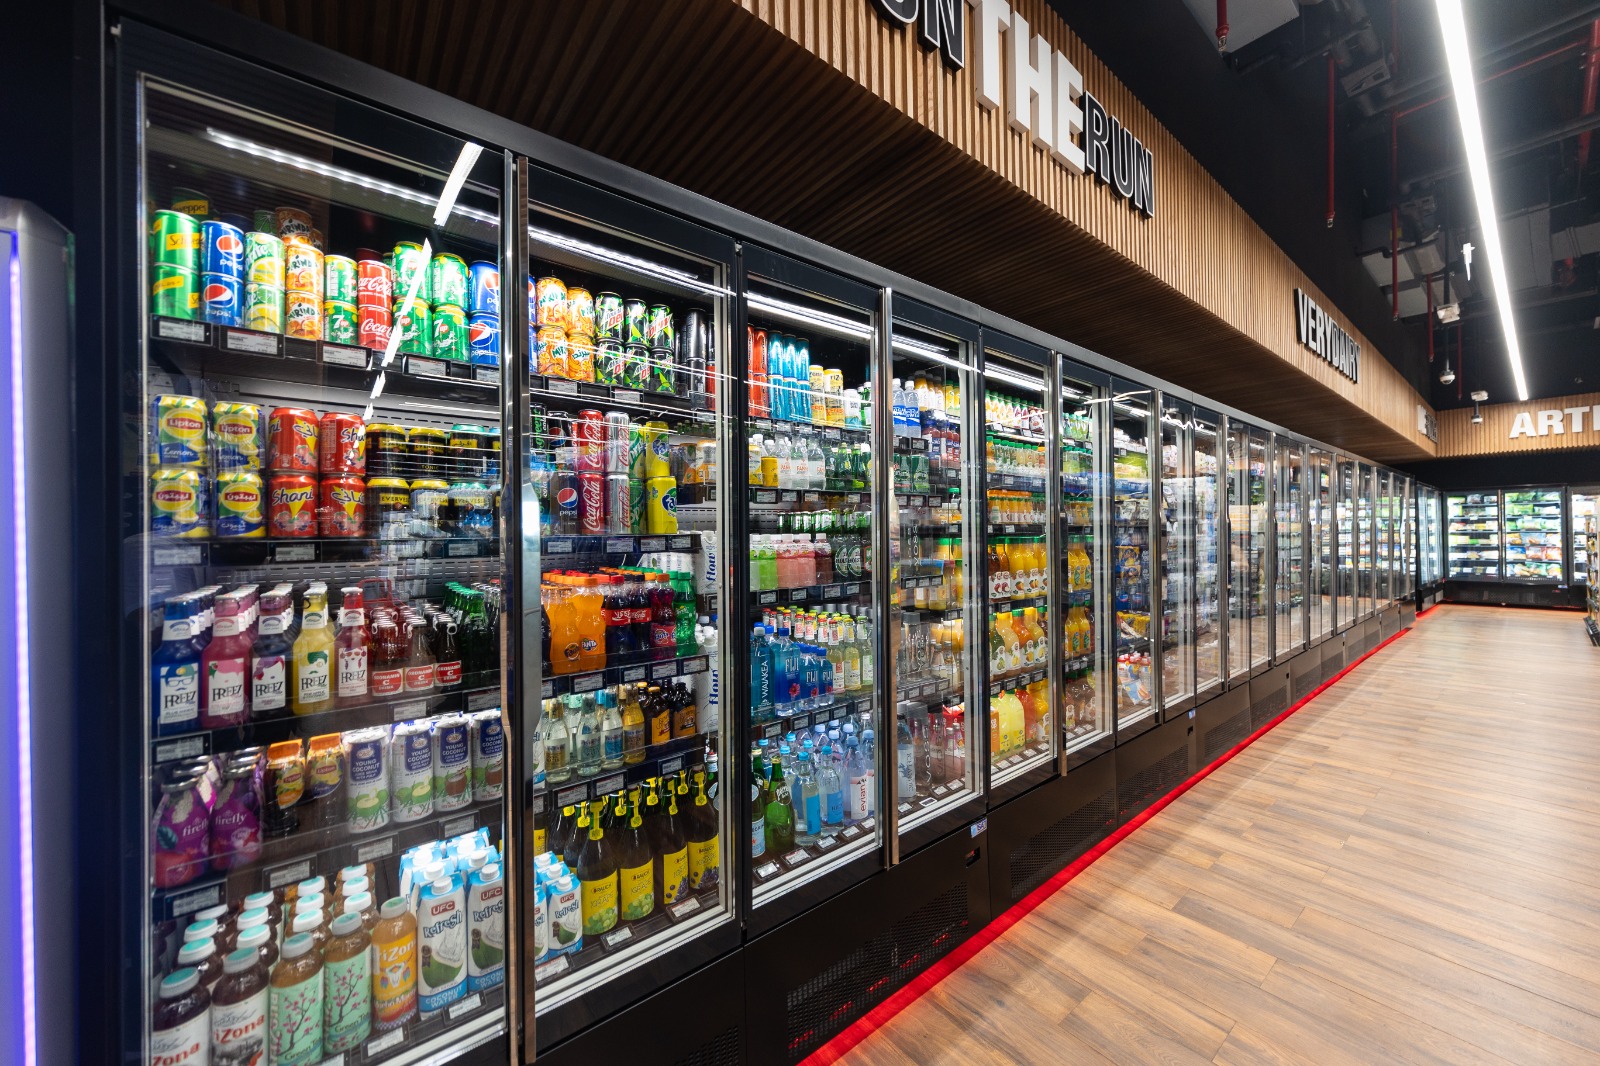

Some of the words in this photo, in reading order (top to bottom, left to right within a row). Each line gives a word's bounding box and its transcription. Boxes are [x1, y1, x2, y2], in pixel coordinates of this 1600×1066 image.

[873, 0, 965, 70] N
[968, 0, 1085, 176] THE
[1084, 89, 1155, 218] RUN
[169, 417, 201, 429] Lipton
[163, 447, 194, 457] Lemon
[226, 492, 257, 502] ليبتون
[272, 487, 315, 506] Shani
[583, 478, 601, 532] Coca-Cola
[560, 509, 578, 518] pepsi
[706, 552, 716, 582] flow
[785, 656, 800, 673] FIJI
[301, 675, 328, 691] FREEZ
[341, 669, 366, 684] FREEZ
[806, 670, 818, 683] FIJI
[211, 684, 243, 701] FREEZ
[254, 681, 284, 698] FREEZ
[411, 748, 430, 756] YOUNG
[442, 746, 467, 756] COCONUT
[445, 742, 464, 750] YOUNG
[355, 758, 377, 767] YOUNG
[407, 752, 431, 763] COCONUT
[352, 762, 380, 773] COCONUT
[859, 782, 867, 812] evian
[215, 812, 247, 825] firefly
[482, 888, 503, 900] UFC
[561, 893, 575, 903] UFC
[432, 902, 455, 915] UFC
[473, 900, 503, 923] Refres
[423, 910, 463, 939] Refresh
[425, 986, 463, 1004] COCONUT
[430, 995, 458, 1009] WATER
[214, 1013, 266, 1045] iZona
[334, 1019, 360, 1034] Green
[152, 1042, 200, 1066] Zona
